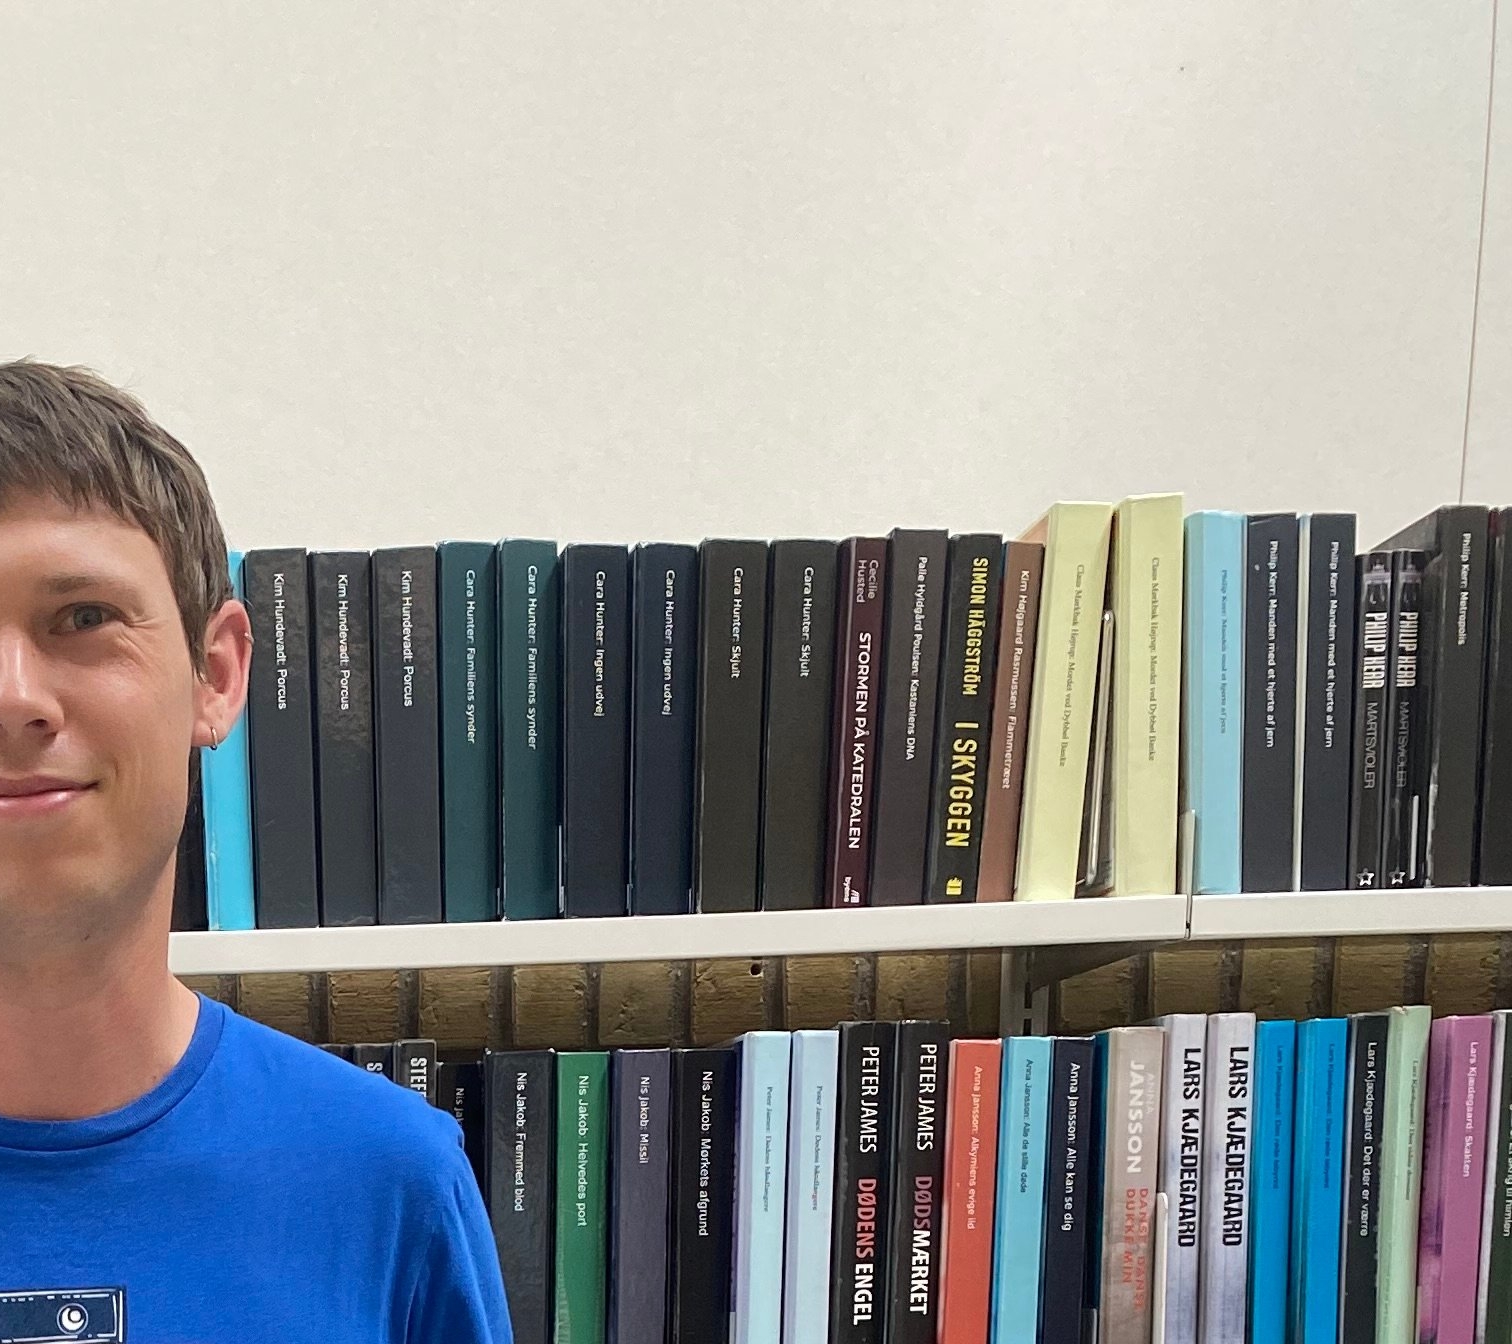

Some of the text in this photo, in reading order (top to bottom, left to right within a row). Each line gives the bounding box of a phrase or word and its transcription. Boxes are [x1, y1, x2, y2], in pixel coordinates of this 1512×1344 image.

[856, 559, 866, 603] Husted
[867, 559, 879, 599] Cecilie
[969, 558, 989, 604] SIMON
[337, 574, 350, 710] Kim Hundevadt: Porcus
[848, 632, 871, 849] STORMEN PÅ KATEDRALEN
[1362, 612, 1386, 788] PHILIP KERR MARTSVIOLER
[945, 739, 977, 847] SKYGGEN
[701, 1071, 713, 1091] Nis
[1127, 1060, 1145, 1173] JANSSON
[699, 1138, 711, 1187] Mørkets
[854, 1046, 879, 1325] PETER JAMES DØDENS ENGEL
[910, 1044, 937, 1314] PETER JAMES DØDSMÆRKET
[1223, 1046, 1248, 1246] LARS KJÆDEGAARD
[698, 1190, 710, 1236] afgrund
